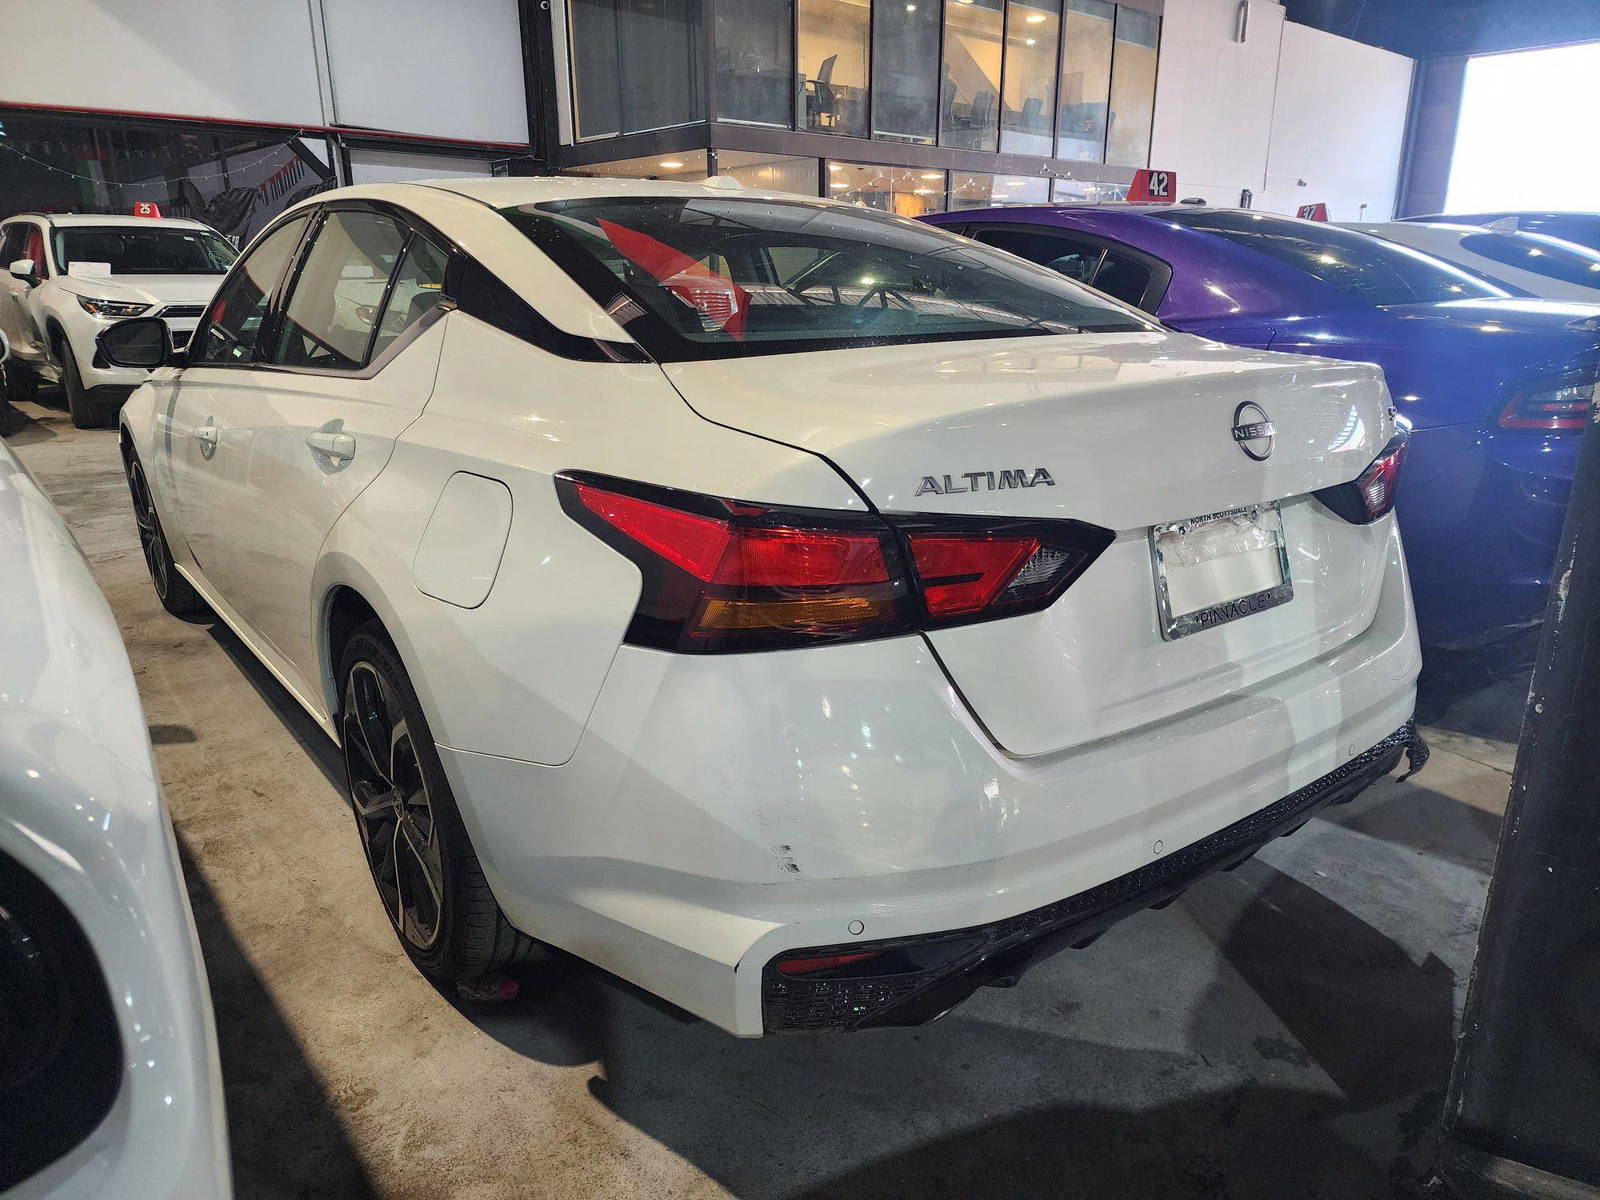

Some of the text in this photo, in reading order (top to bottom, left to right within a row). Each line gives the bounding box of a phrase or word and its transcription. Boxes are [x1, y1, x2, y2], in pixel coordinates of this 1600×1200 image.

[1150, 173, 1168, 196] 42
[140, 203, 151, 214] 25
[914, 467, 1056, 497] ALTIMA
[1190, 506, 1247, 525] NORTH SCOTTSDALE
